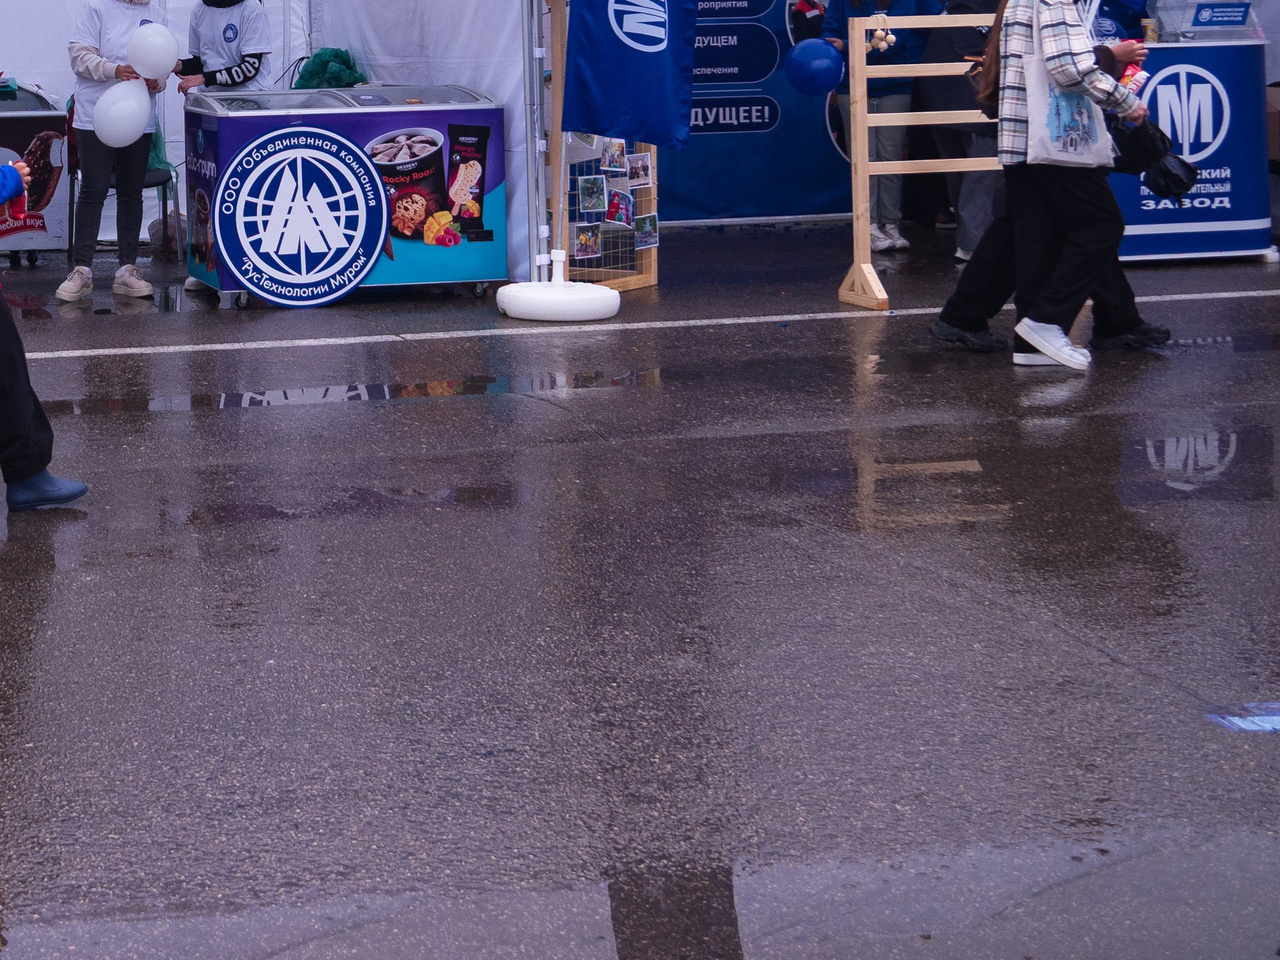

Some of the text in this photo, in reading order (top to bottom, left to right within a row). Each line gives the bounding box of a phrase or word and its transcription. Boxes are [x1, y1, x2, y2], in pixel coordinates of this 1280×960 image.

[698, 0, 748, 10] роприятия
[694, 35, 738, 48] ДУЩЕМ
[690, 106, 770, 127] ДУЩЕЕ!
[382, 165, 435, 183] Rocky Road
[222, 177, 241, 215] ООО
[339, 150, 376, 207] компания
[1141, 197, 1231, 210] ЗАВОД
